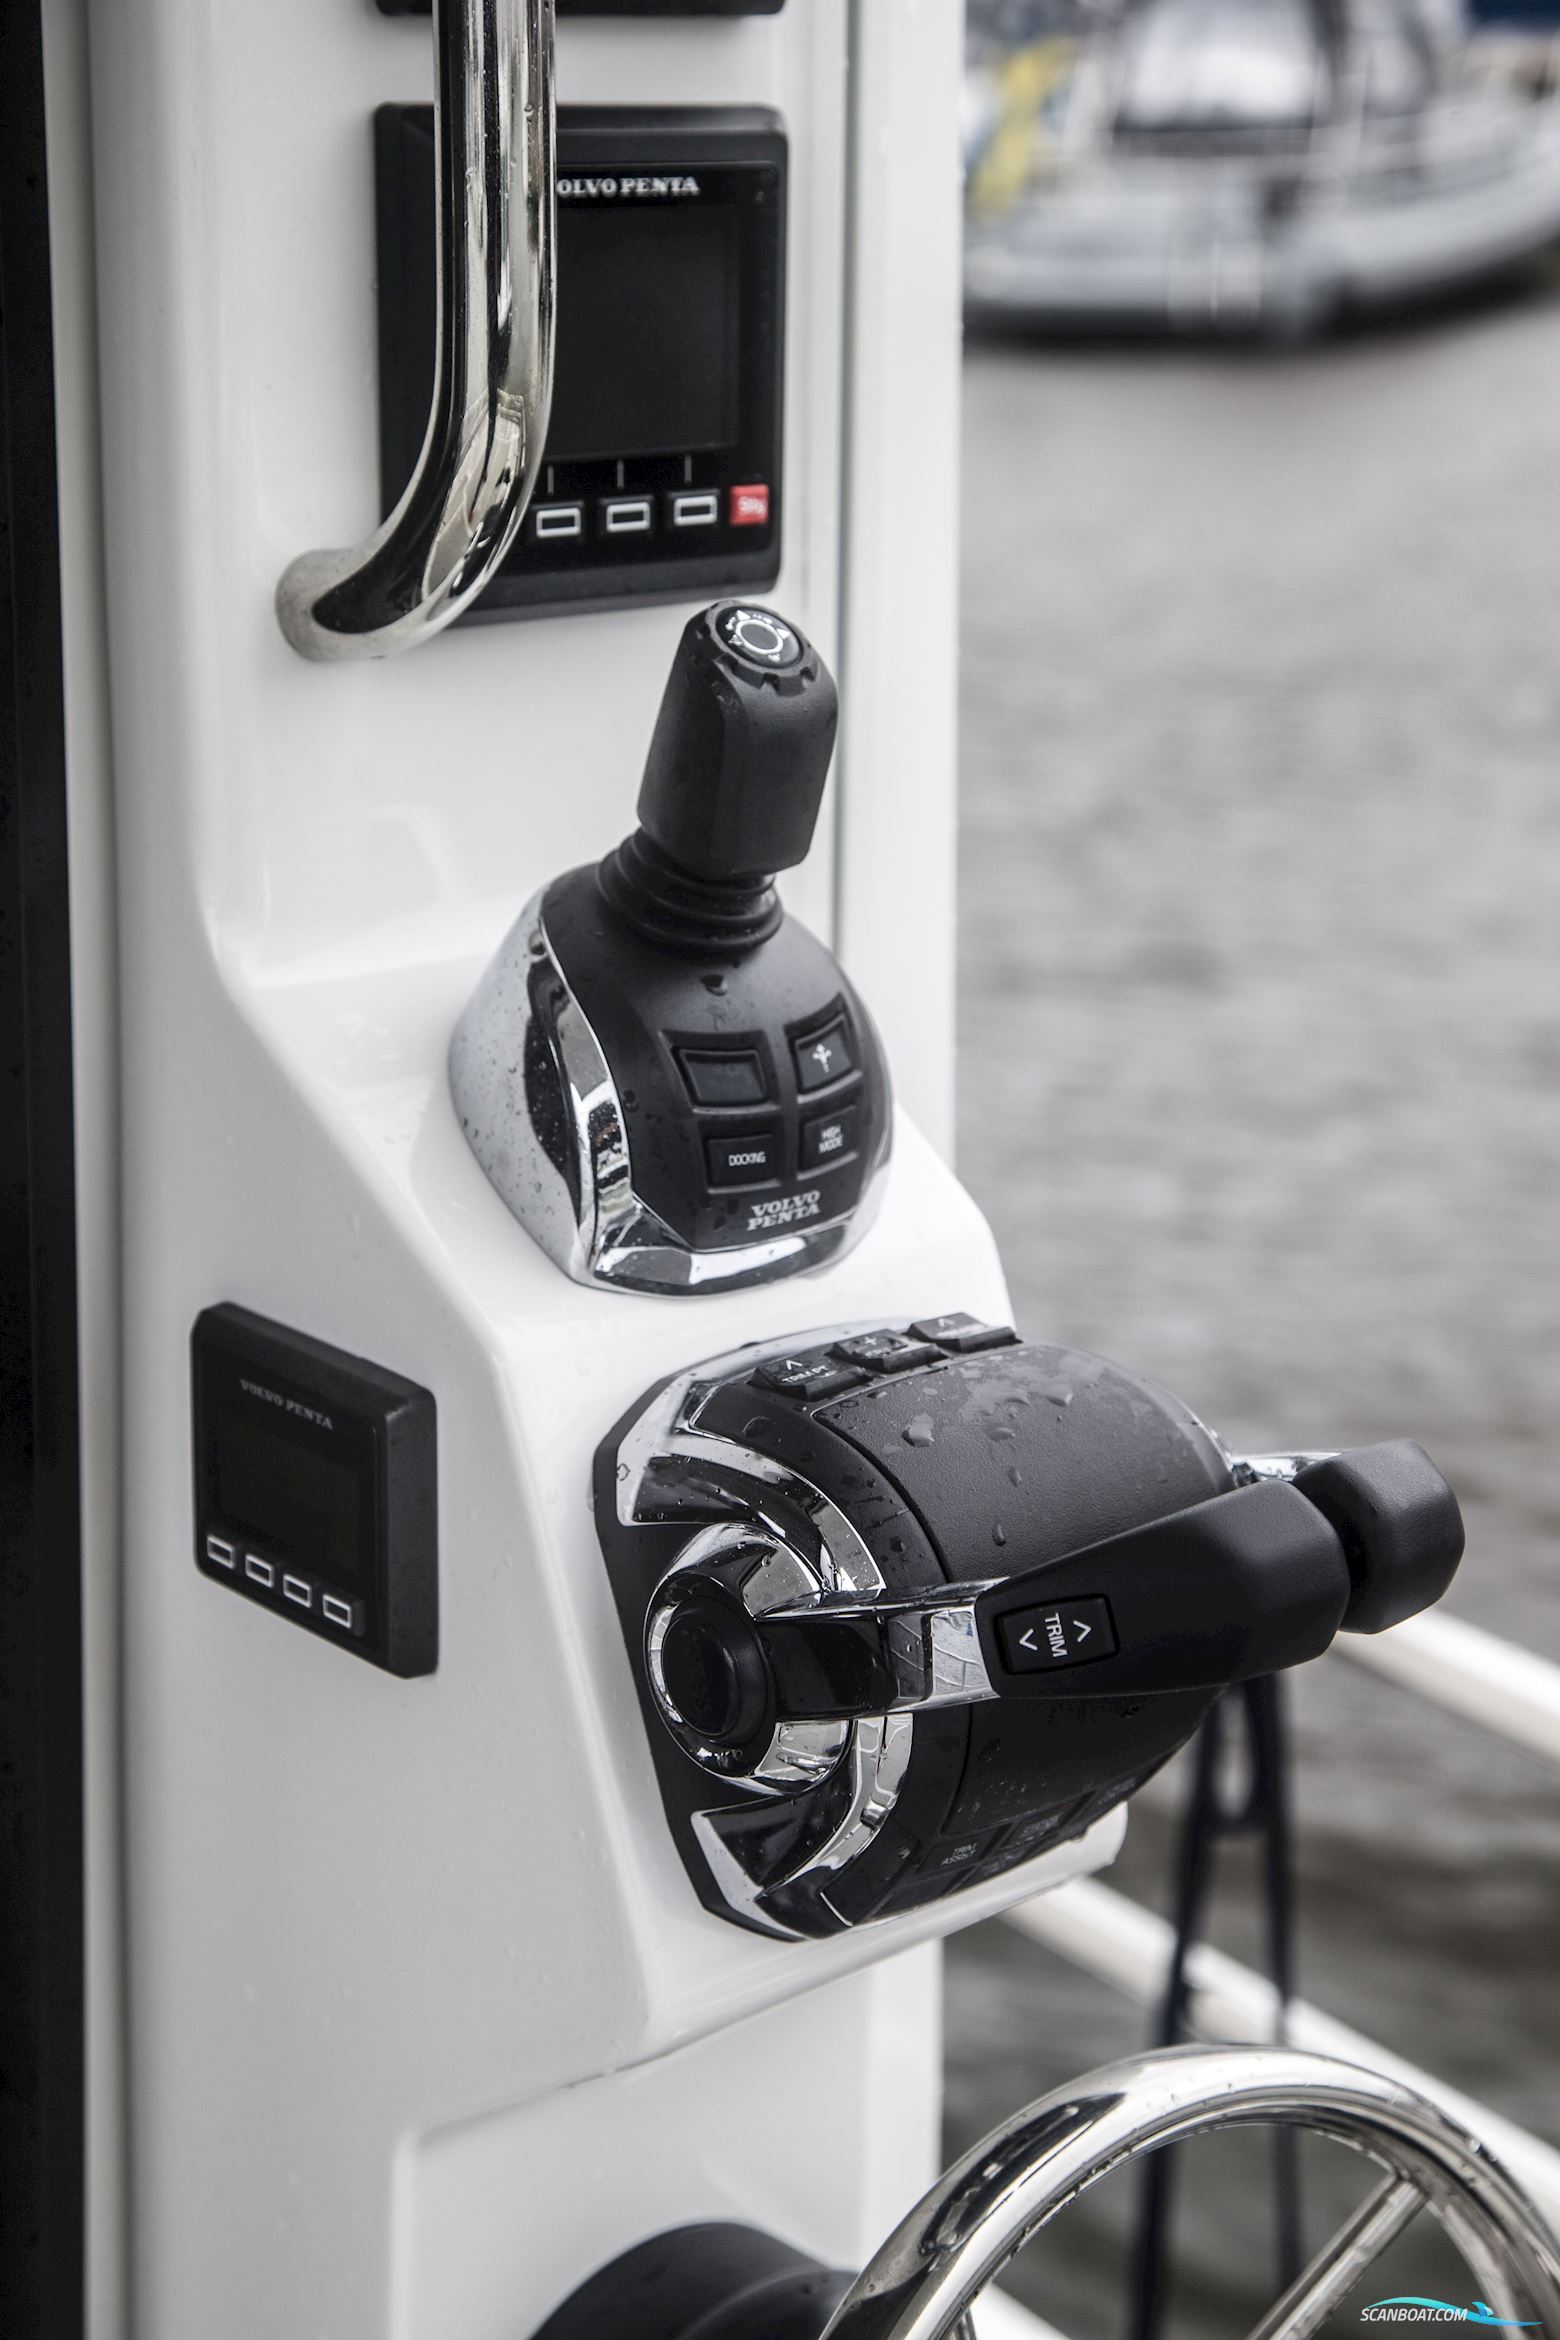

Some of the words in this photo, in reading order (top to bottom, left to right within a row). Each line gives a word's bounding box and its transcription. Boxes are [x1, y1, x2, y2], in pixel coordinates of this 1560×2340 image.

[556, 178, 619, 196] OLVO
[619, 176, 700, 195] PENTA
[728, 1151, 766, 1167] DOCKING
[747, 1203, 820, 1231] PENTA
[751, 1190, 821, 1217] VOLVO
[240, 1379, 284, 1407] VOLVO
[285, 1399, 333, 1430] PENTA
[1045, 1612, 1068, 1658] TRIM
